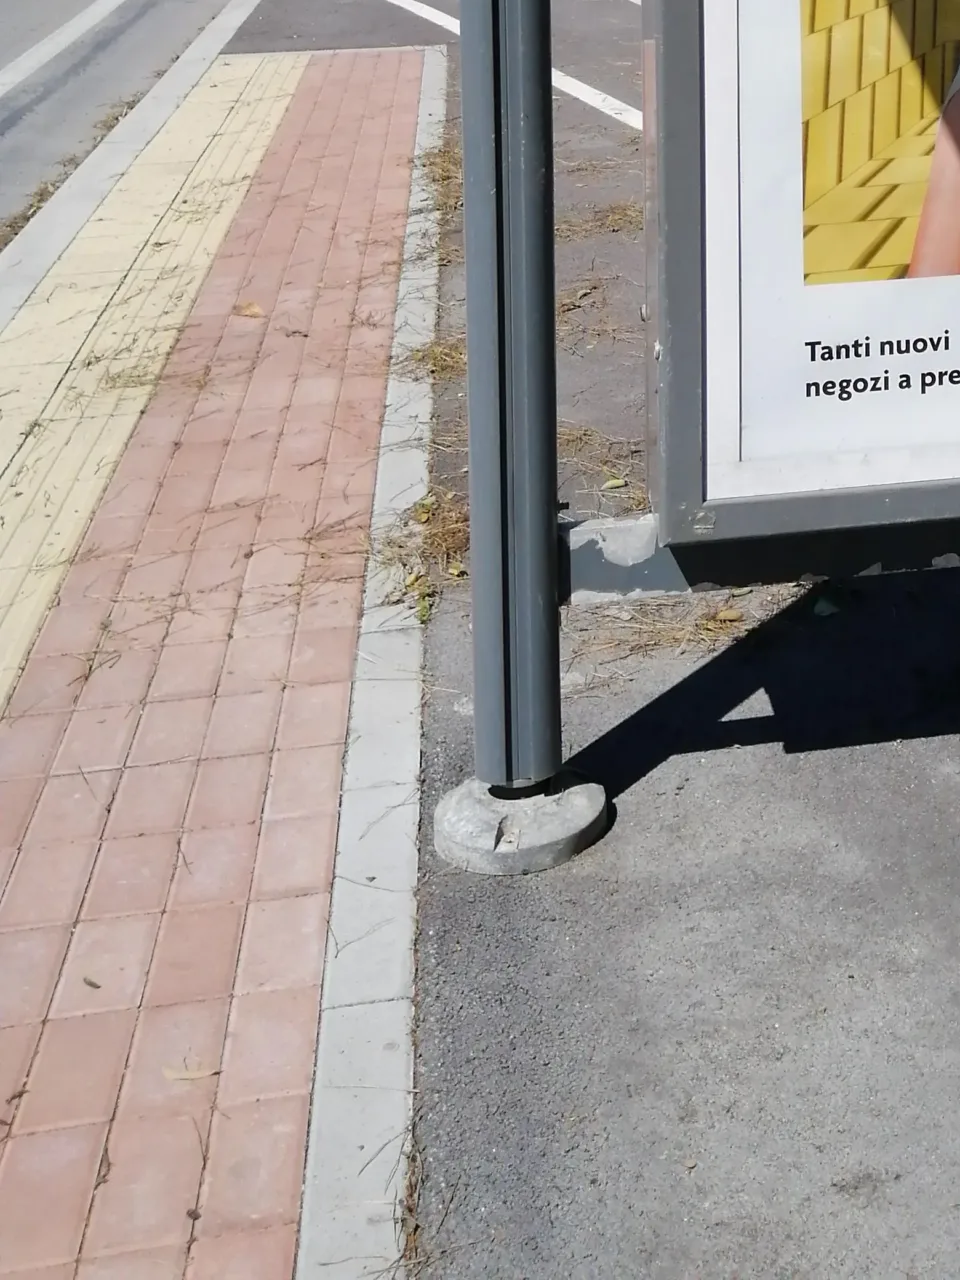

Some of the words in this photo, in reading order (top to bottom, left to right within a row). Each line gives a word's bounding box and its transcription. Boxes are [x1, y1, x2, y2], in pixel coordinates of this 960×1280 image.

[805, 336, 871, 362] Tanti
[879, 329, 950, 356] nuovi
[805, 369, 890, 402] negozi
[898, 372, 912, 390] a
